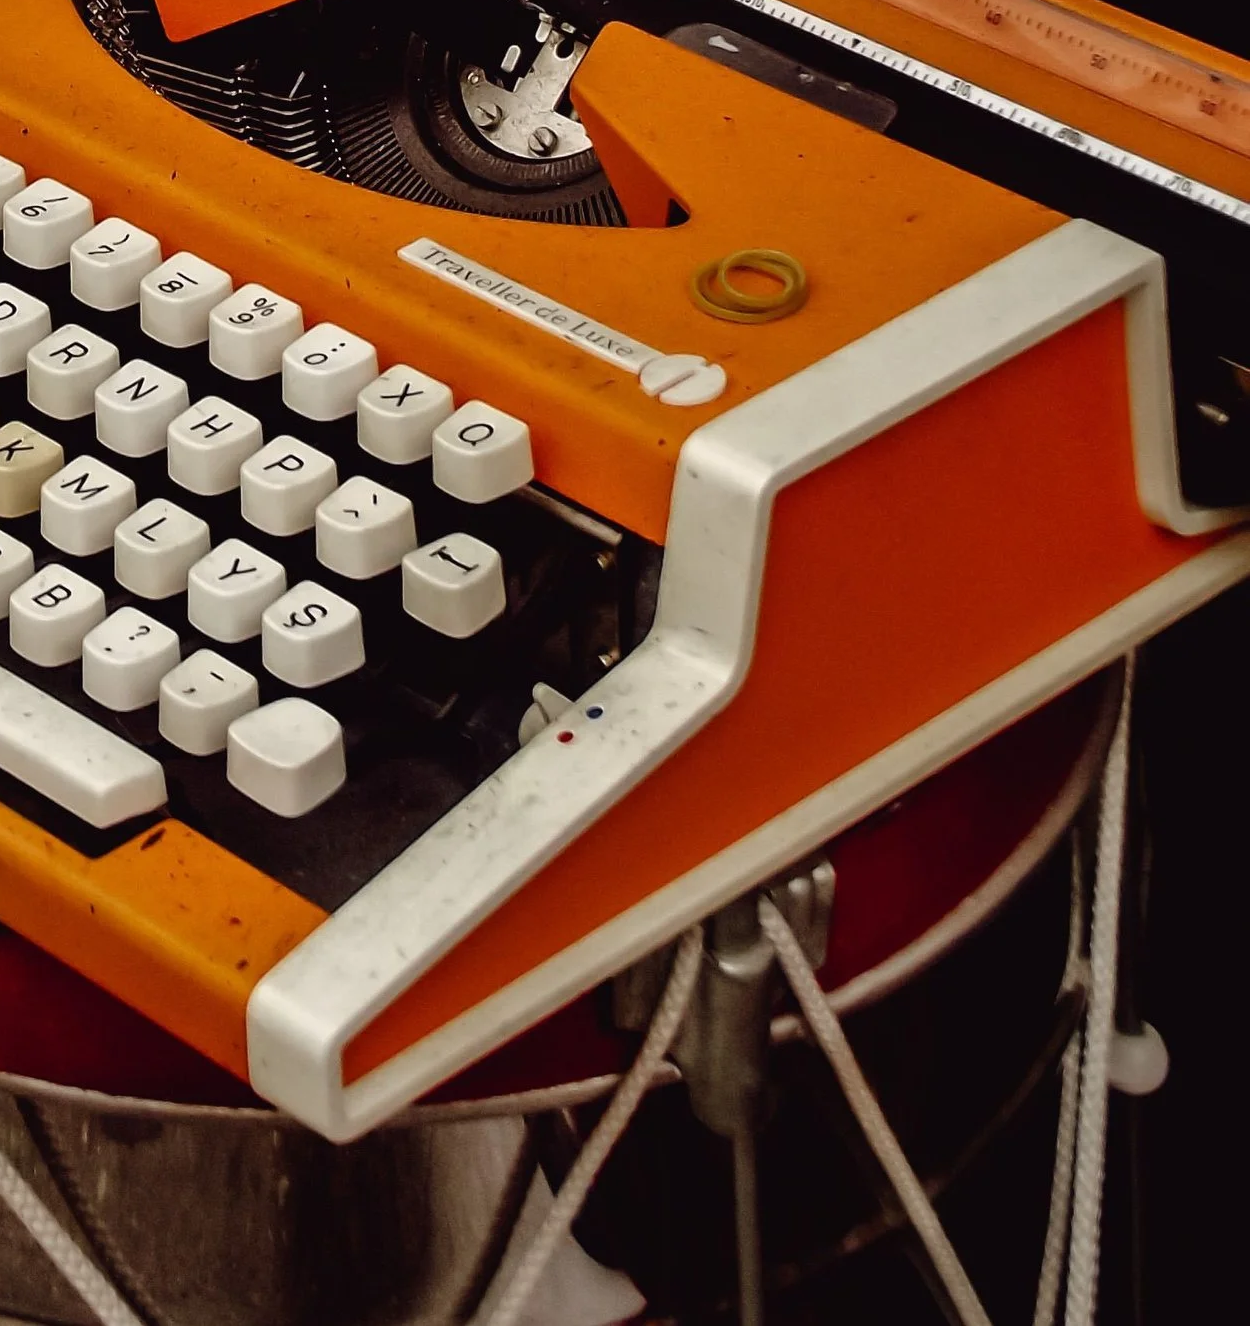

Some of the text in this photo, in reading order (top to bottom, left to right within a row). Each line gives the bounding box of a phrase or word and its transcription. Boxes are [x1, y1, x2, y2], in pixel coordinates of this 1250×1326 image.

[984, 8, 1003, 26] 40
[20, 205, 47, 217] 6
[87, 244, 115, 255] 7
[157, 280, 184, 294] 8
[423, 247, 634, 359] Traveller de Luxe
[228, 312, 254, 325] 9
[49, 341, 89, 365] R
[116, 377, 159, 401] N
[380, 383, 424, 407] X
[190, 414, 234, 439] H
[457, 423, 494, 447] Q
[263, 454, 305, 472] P
[60, 472, 109, 501] M
[137, 517, 167, 542] L
[218, 558, 257, 581] Y
[32, 584, 72, 608] B
